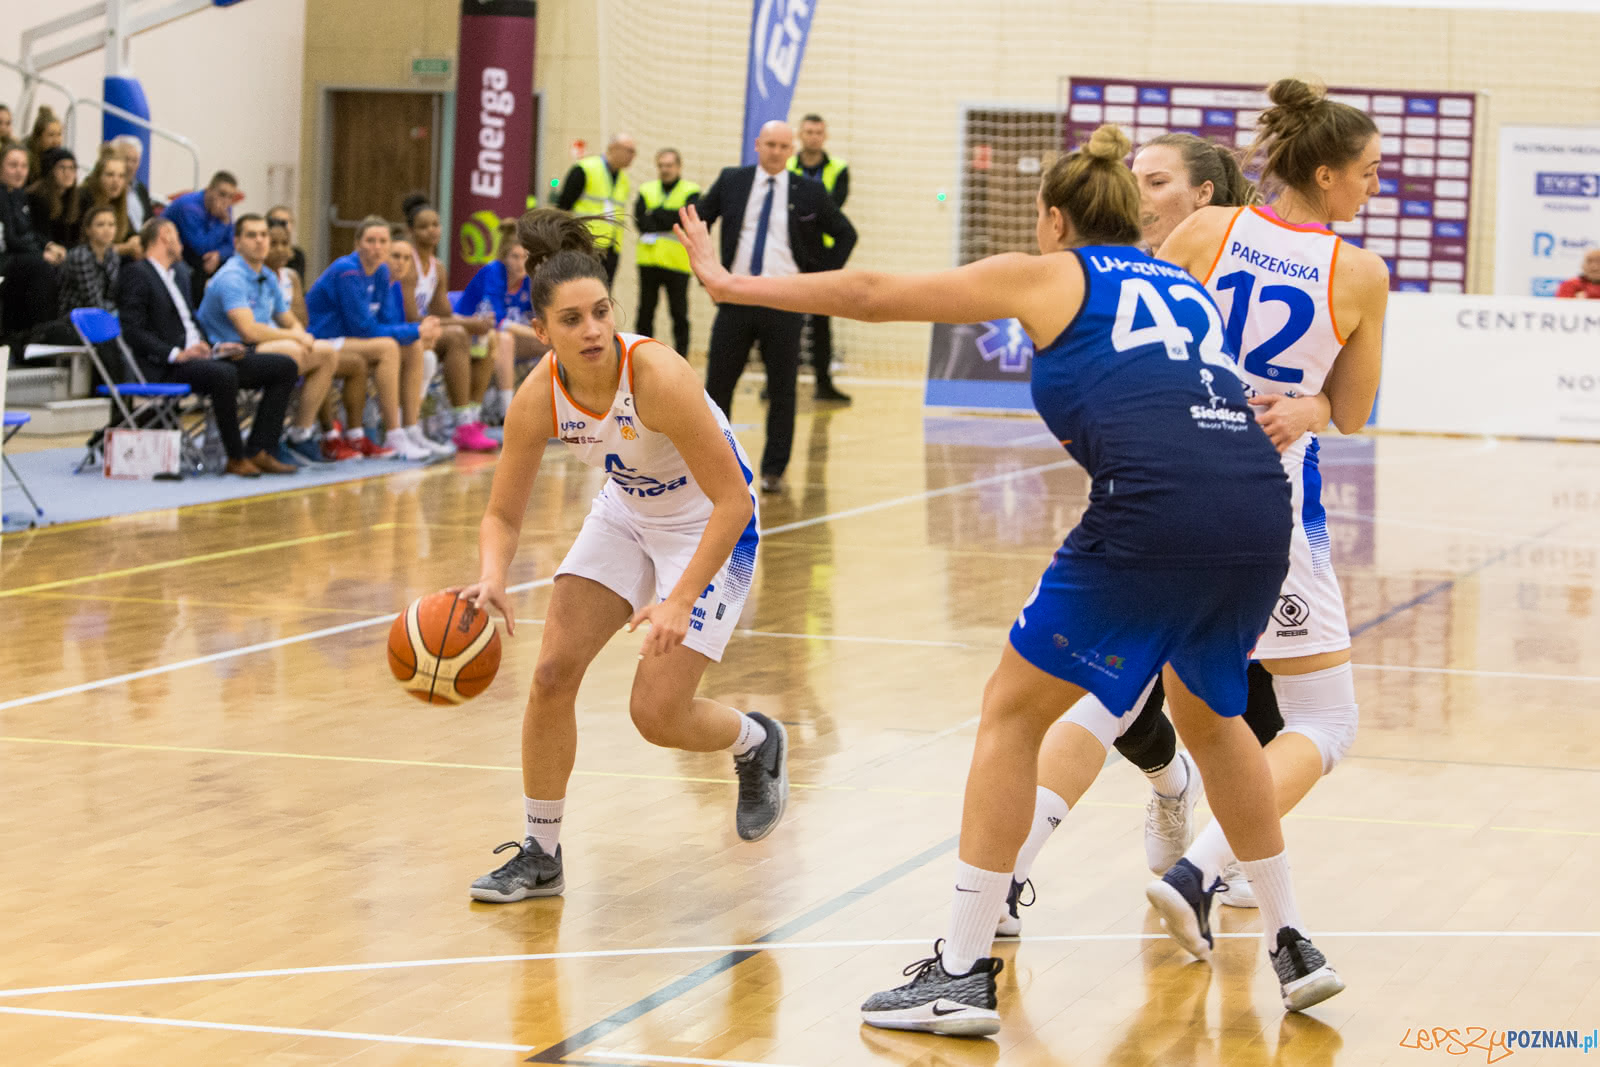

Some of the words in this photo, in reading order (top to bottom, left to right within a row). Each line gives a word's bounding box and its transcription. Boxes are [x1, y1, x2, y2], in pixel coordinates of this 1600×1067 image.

[470, 67, 515, 198] Energa
[1231, 241, 1320, 283] PARZEŃSKA
[1111, 278, 1240, 366] 42
[1216, 270, 1315, 384] 12
[1456, 309, 1600, 333] CENTRUM
[1557, 375, 1600, 391] NO
